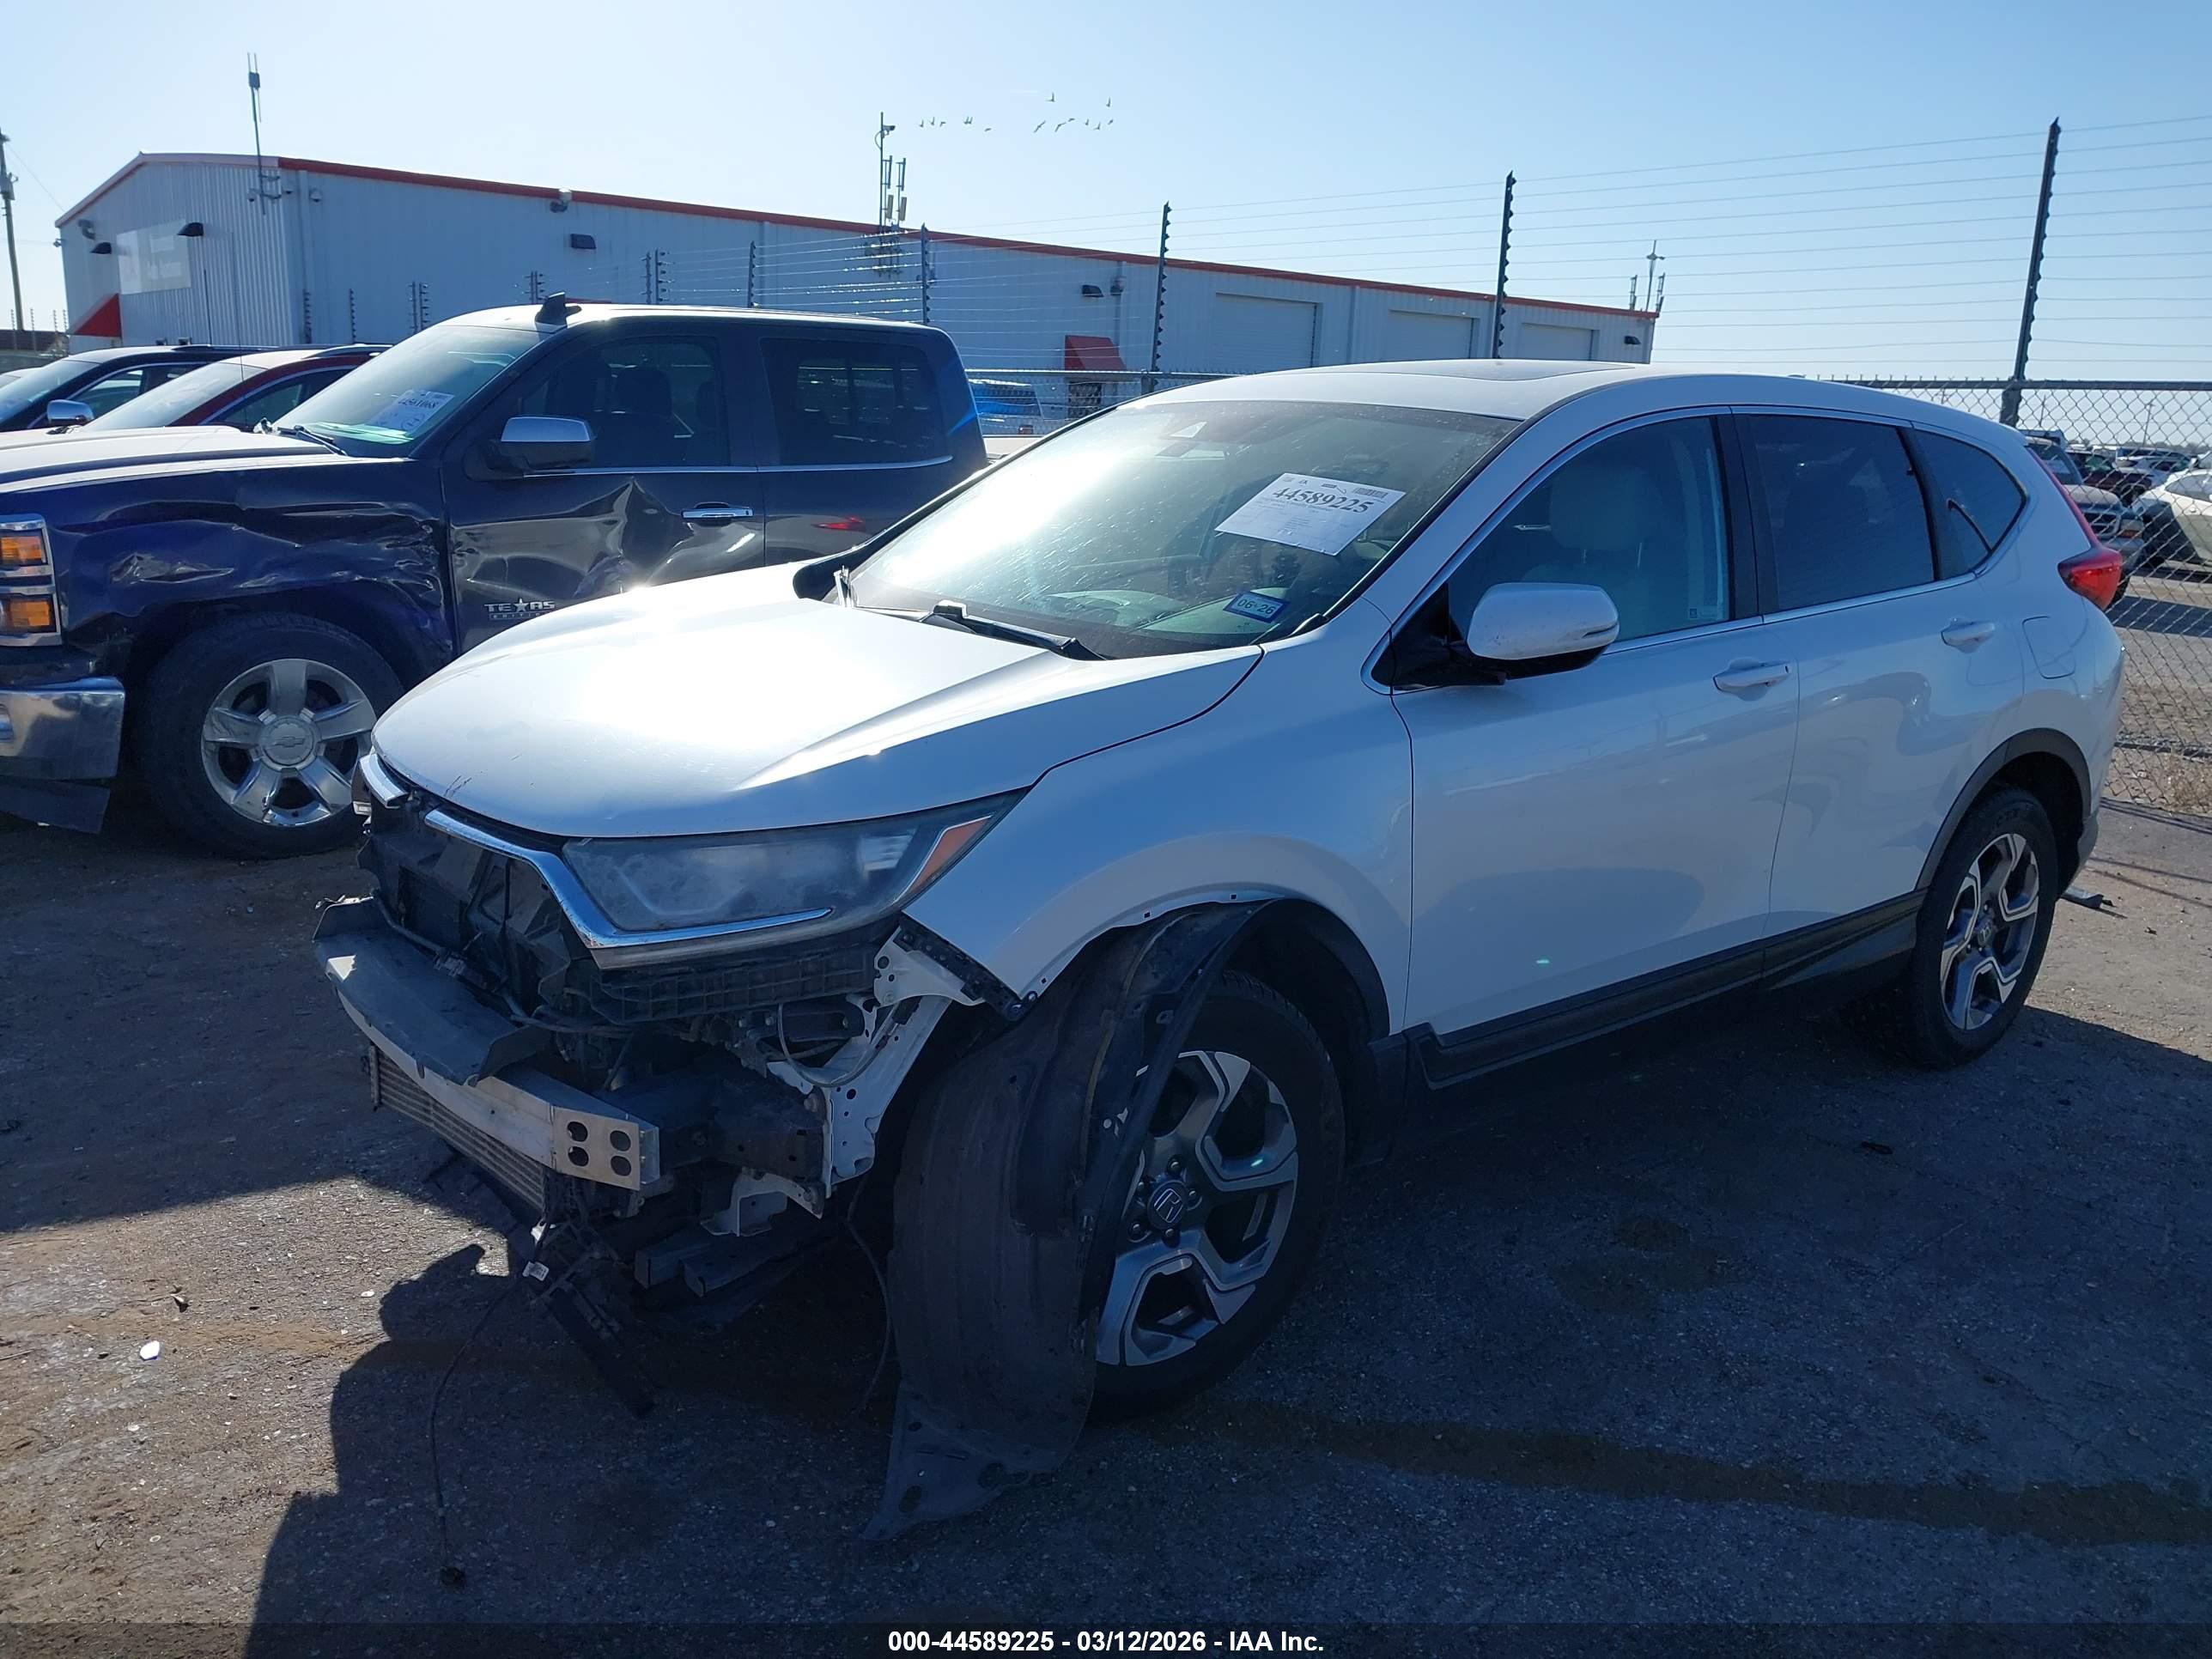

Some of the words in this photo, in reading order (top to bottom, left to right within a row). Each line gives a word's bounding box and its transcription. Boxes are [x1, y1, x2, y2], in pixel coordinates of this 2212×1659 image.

[1273, 487, 1374, 514] 44589225
[1237, 599, 1255, 609] 06
[1257, 604, 1276, 615] 26
